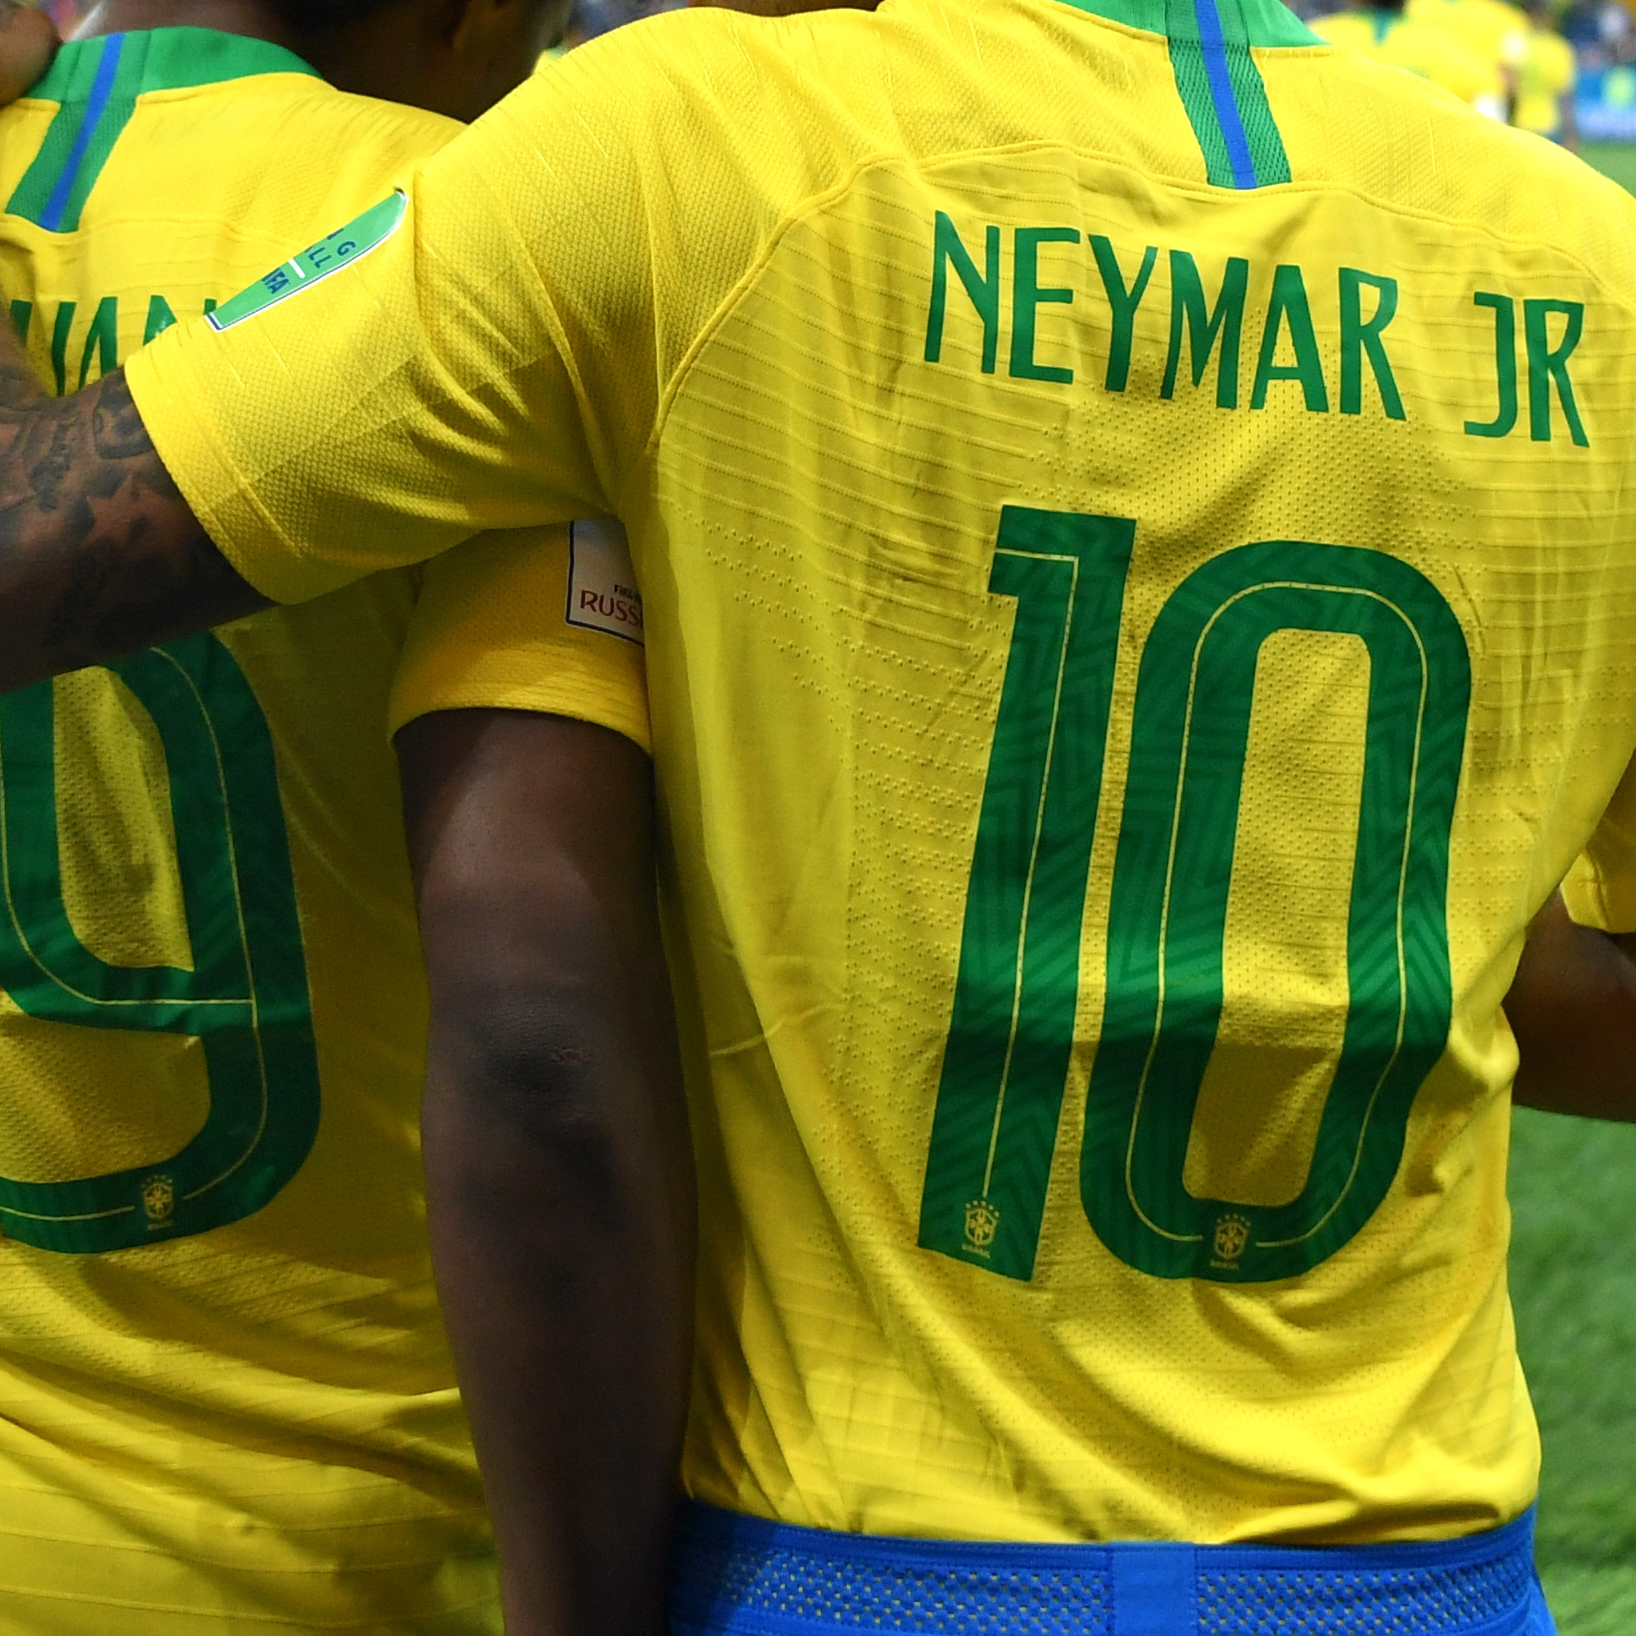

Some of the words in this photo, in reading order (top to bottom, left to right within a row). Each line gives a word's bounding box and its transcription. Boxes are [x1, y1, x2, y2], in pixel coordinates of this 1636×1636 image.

[923, 210, 1406, 421] NEYMAR
[1464, 292, 1590, 447] JR
[917, 504, 1473, 1283] 10
